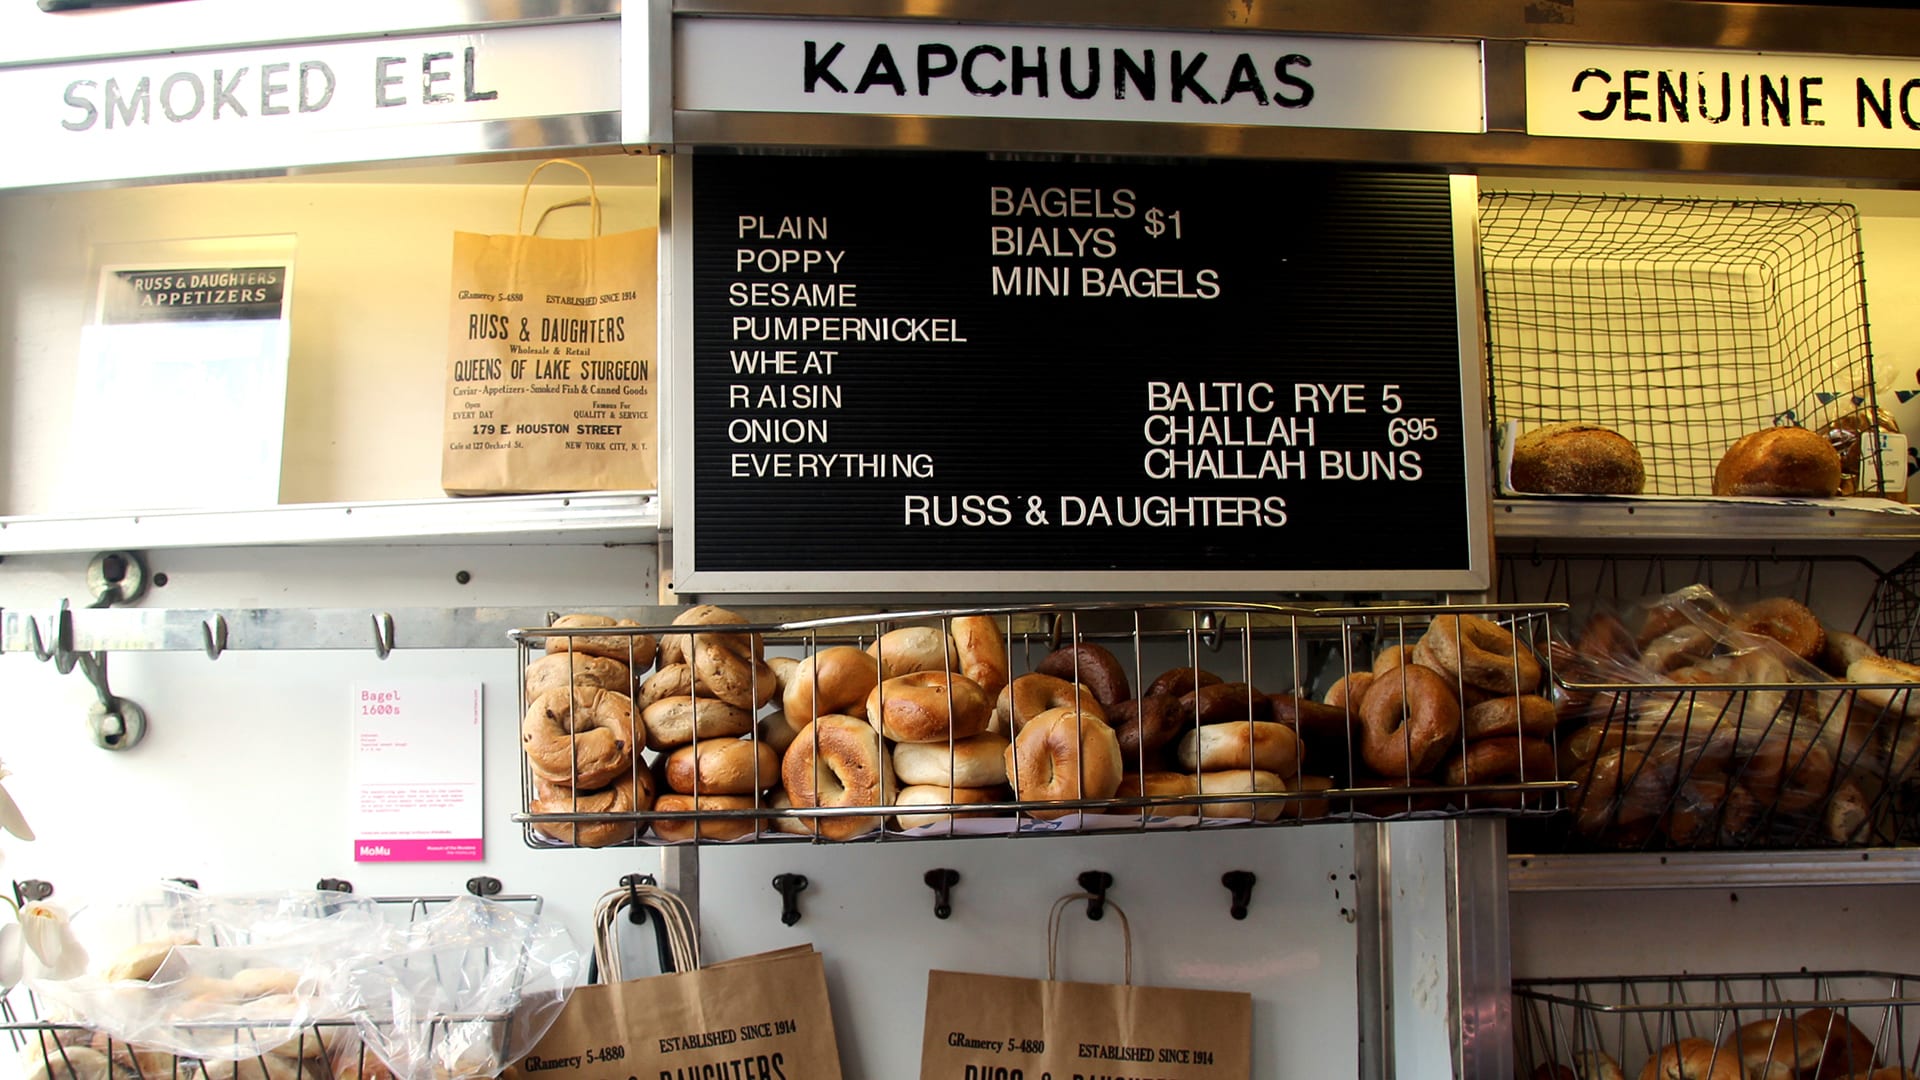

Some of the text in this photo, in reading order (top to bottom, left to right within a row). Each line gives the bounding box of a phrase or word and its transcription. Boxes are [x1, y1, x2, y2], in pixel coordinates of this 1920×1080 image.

[803, 40, 1315, 109] KAPCHUNKAS
[61, 46, 498, 132] SMOKED EEL
[1571, 67, 1826, 128] GENUINE
[991, 186, 1137, 219] BAGELS
[738, 215, 828, 240] PLAIN
[1144, 206, 1182, 240] $1
[991, 226, 1117, 259] BIALYS
[736, 248, 846, 274] POPPY
[134, 271, 277, 291] RUSS & DAUGHTERS
[992, 266, 1221, 299] MINI BAGELS
[142, 288, 267, 307] APPETIZERS
[546, 290, 637, 307] ESTABLISHED SINCE 1914
[729, 282, 857, 307] SESAME
[469, 313, 625, 344] RUSS & DAUGHTERS
[733, 316, 968, 343] PUMPERNICKEL
[510, 344, 550, 355] Wholesale
[565, 346, 591, 356] Retail
[454, 358, 649, 382] QUEENS OF LAKE STURGEON
[729, 350, 839, 376] WHEAT
[562, 384, 580, 394] Fish
[590, 385, 621, 395] Canned
[623, 385, 648, 396] Goods
[729, 384, 842, 409] RAISIN
[1148, 381, 1402, 414] BALTIC RYE 5
[452, 410, 494, 420] EVERY DAY
[573, 410, 607, 419] QUALITY
[618, 411, 648, 420] SERVICE
[472, 424, 623, 436] 179 E. HOUSTON STREET
[727, 419, 828, 443] ONION
[1144, 414, 1315, 447] CHALLAH
[564, 441, 583, 450] NEW
[731, 453, 935, 479] EVERYTHING
[1144, 449, 1424, 482] CHALLAH BUNS
[904, 494, 1290, 528] RUSS & DAUGHTERS
[361, 690, 401, 704] Bagel
[361, 704, 401, 716] 1600s
[360, 846, 391, 856] MoMu
[659, 1019, 797, 1054] ESTABLISHED SINCE 1914
[948, 1032, 1046, 1054] GRamercy 5-4880
[524, 1045, 626, 1073] GRamercy 5-4880
[659, 1051, 788, 1080] HTERS
[1078, 1043, 1214, 1066] ESTABLISHED SINCE 1914
